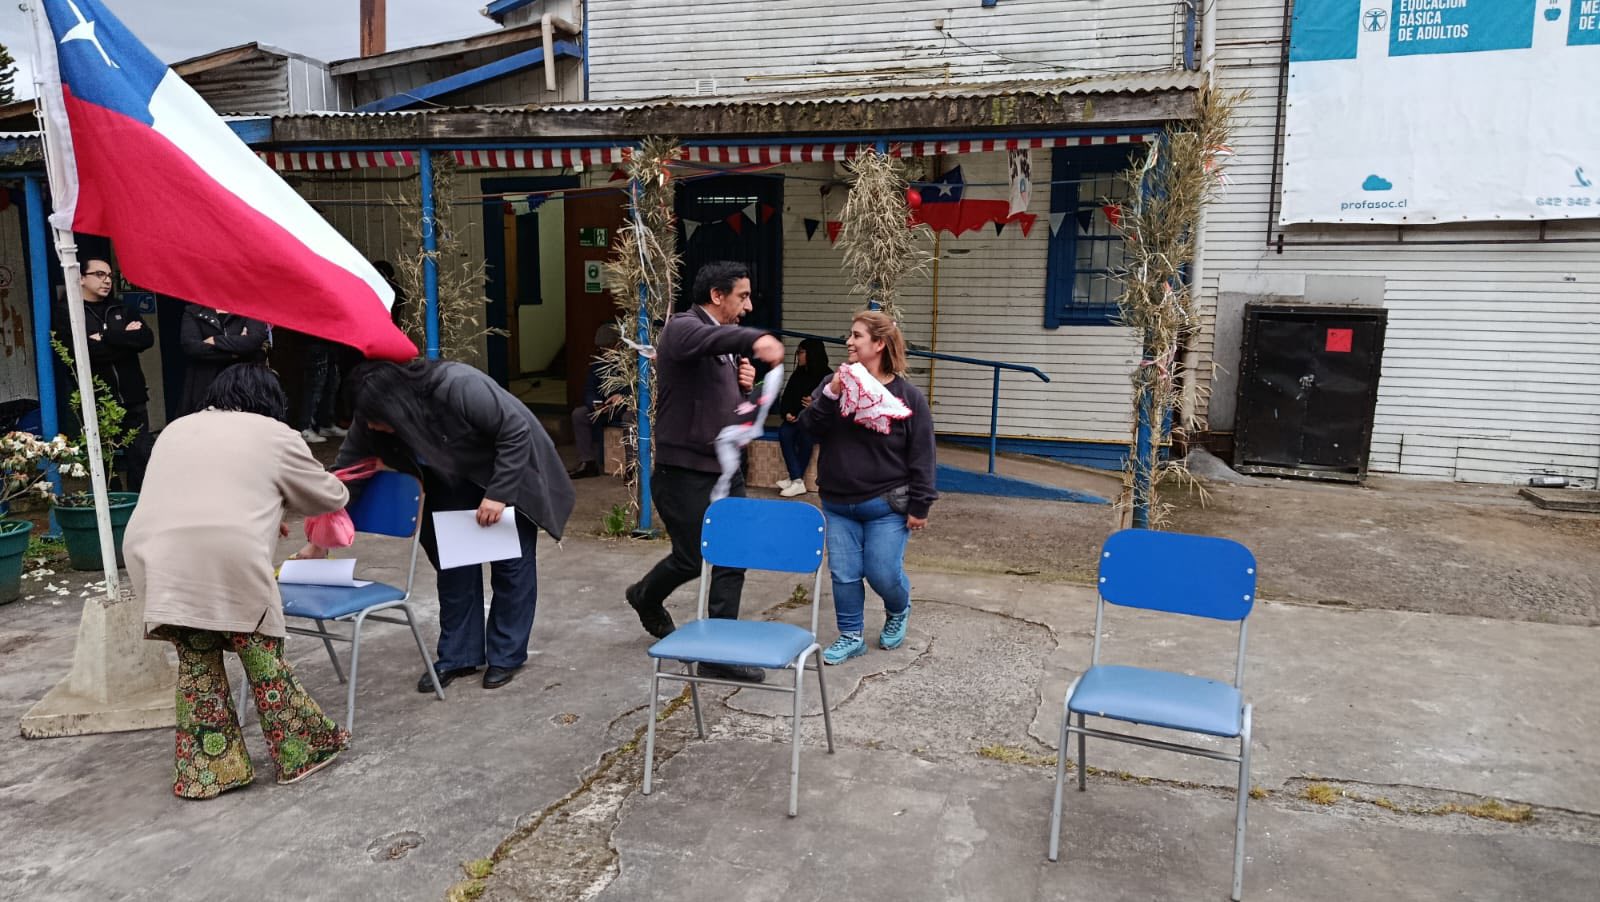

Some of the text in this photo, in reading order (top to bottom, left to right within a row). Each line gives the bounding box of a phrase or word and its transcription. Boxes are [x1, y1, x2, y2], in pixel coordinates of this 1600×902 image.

[1579, 15, 1596, 30] DE
[1398, 23, 1469, 41] DE ADULTOS
[1340, 199, 1407, 211] profasoc.cl
